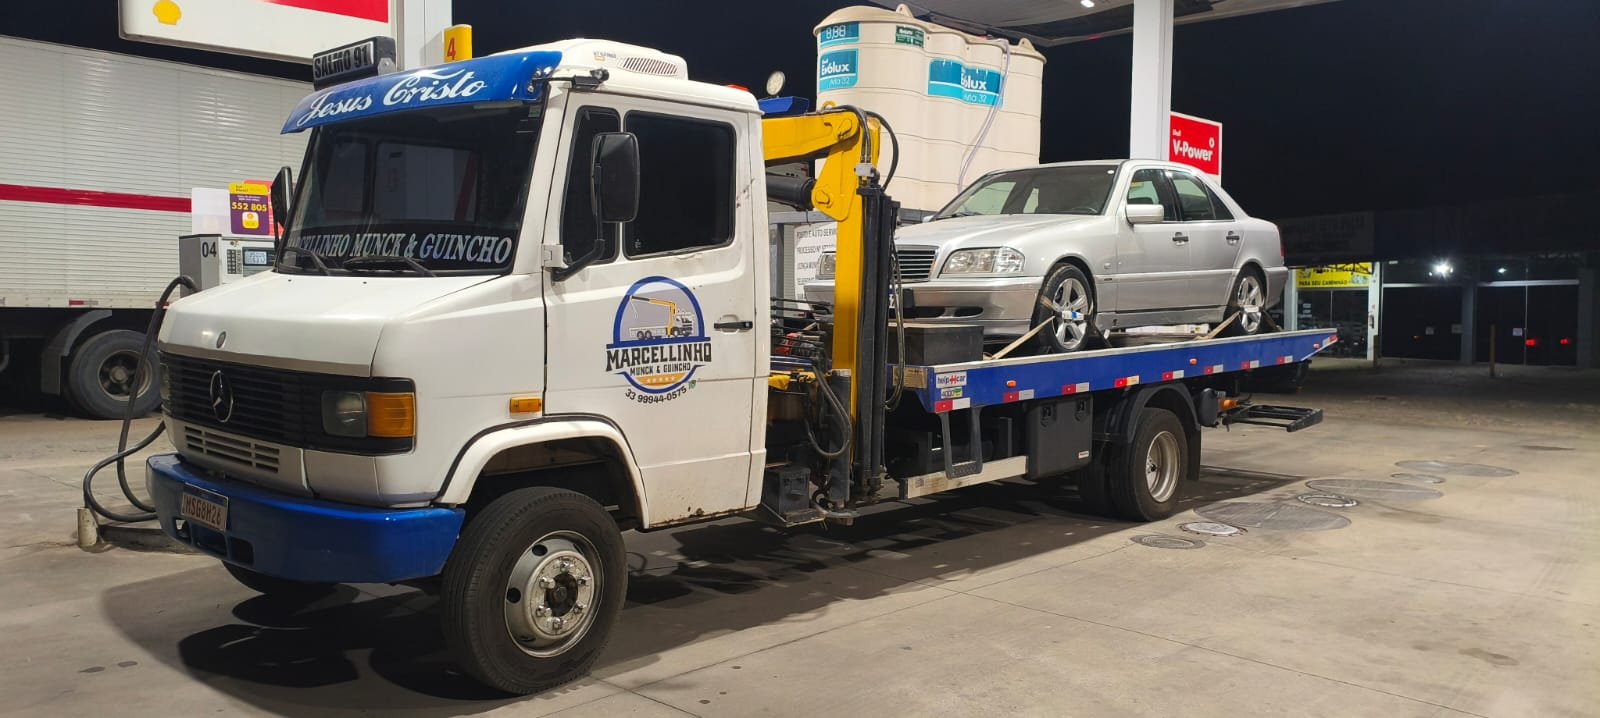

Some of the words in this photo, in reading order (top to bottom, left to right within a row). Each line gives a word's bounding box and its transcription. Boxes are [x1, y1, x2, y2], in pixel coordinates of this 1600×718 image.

[446, 37, 457, 61] 4
[314, 51, 351, 79] SALMO
[354, 44, 371, 69] 91
[296, 91, 372, 127] Jesus
[383, 68, 487, 106] Cristo
[1172, 138, 1213, 162] V-Power
[231, 201, 249, 210] 552
[251, 203, 267, 212] 805
[202, 241, 217, 258] 04
[350, 233, 406, 258] MUNCK
[404, 233, 417, 258] &
[420, 233, 512, 264] GUINCHO
[605, 342, 712, 372] MARCELLINHO
[630, 365, 654, 376] MUNCK
[656, 365, 661, 373] &
[663, 362, 691, 373] GUINCHO
[625, 388, 636, 401] 33
[637, 385, 687, 404] 99944-0575
